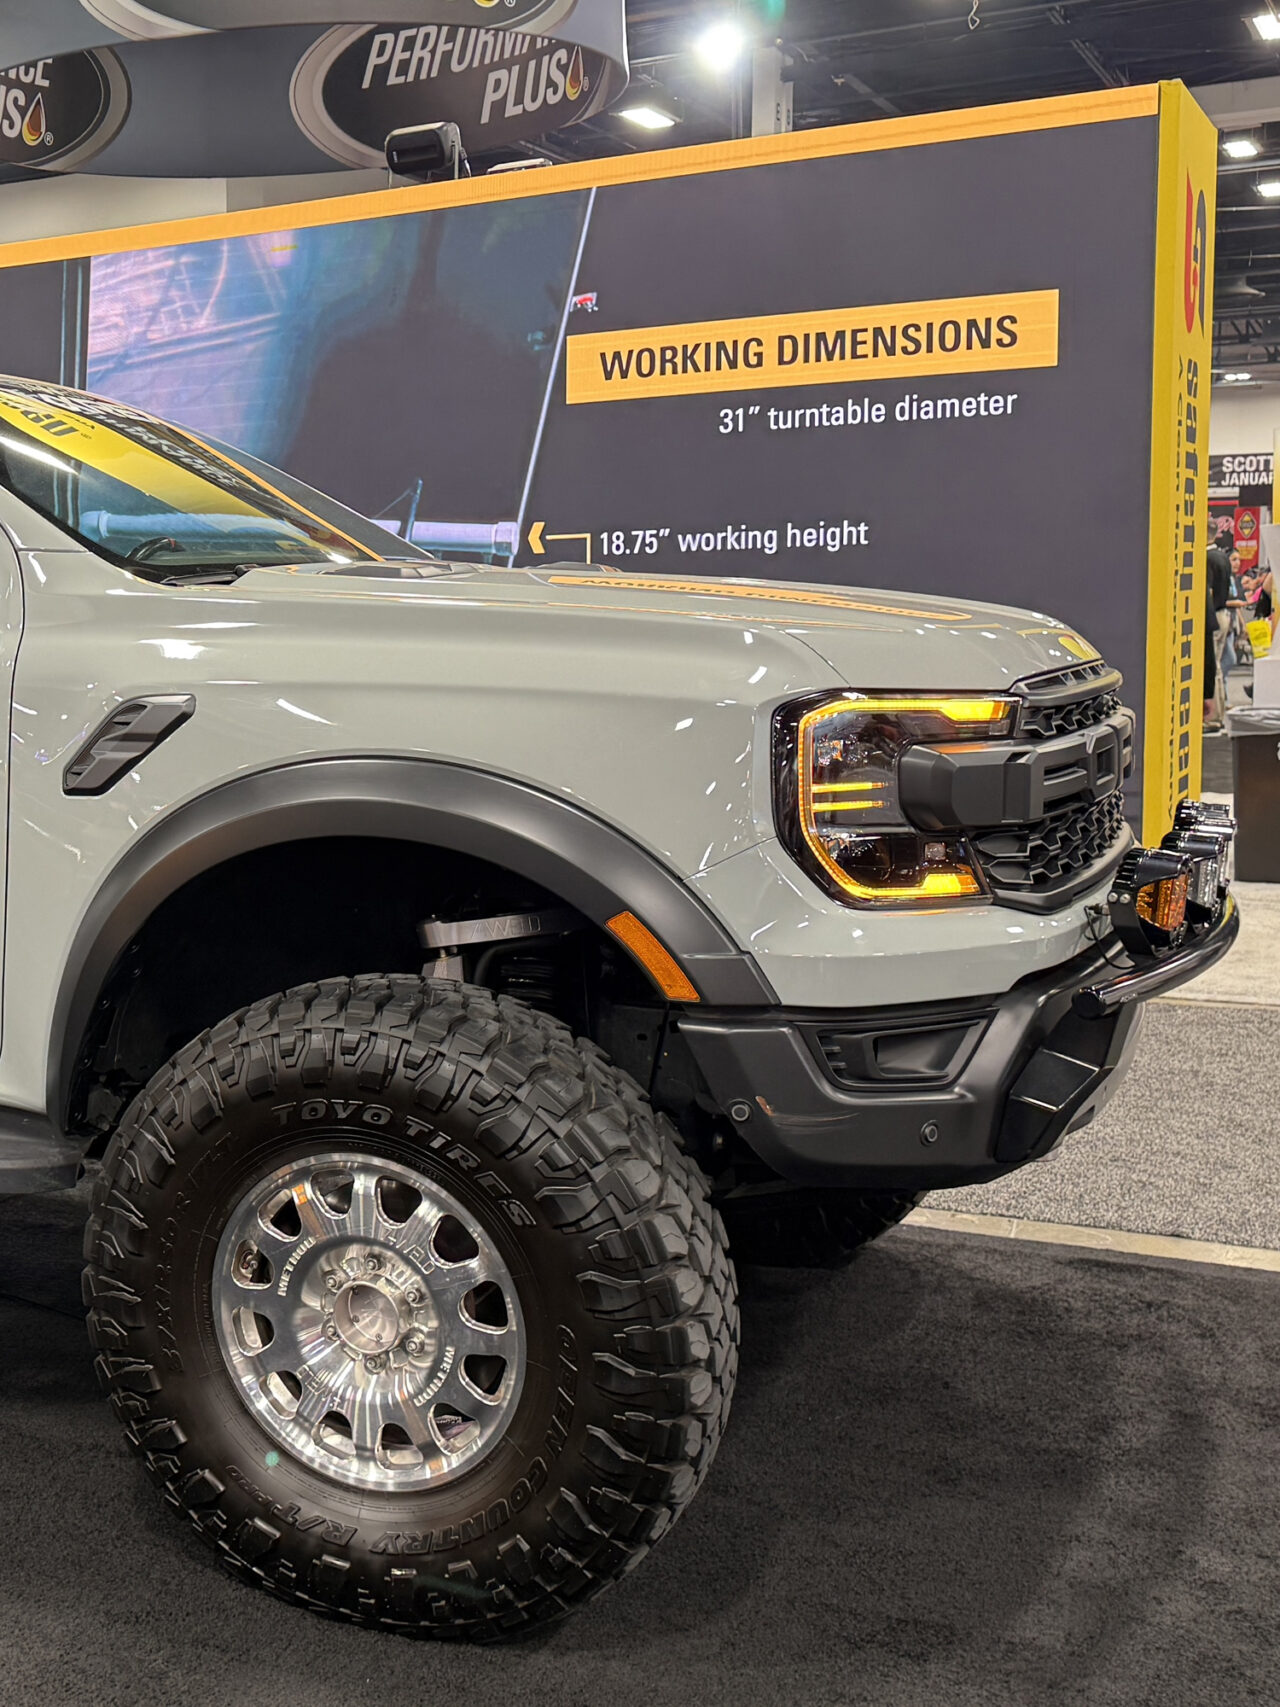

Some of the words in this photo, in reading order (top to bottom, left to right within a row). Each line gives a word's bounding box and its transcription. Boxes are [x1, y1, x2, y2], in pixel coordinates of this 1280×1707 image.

[480, 48, 568, 124] PLUS
[600, 337, 764, 381] WORKING
[777, 315, 1019, 368] DIMENSIONS
[767, 397, 886, 431] turntable
[894, 391, 1018, 424] diameter
[677, 525, 778, 557] working
[786, 520, 869, 556] height
[271, 1098, 393, 1126] TOYO
[404, 1115, 537, 1226] TIRES
[370, 1456, 548, 1554] COUNTRY
